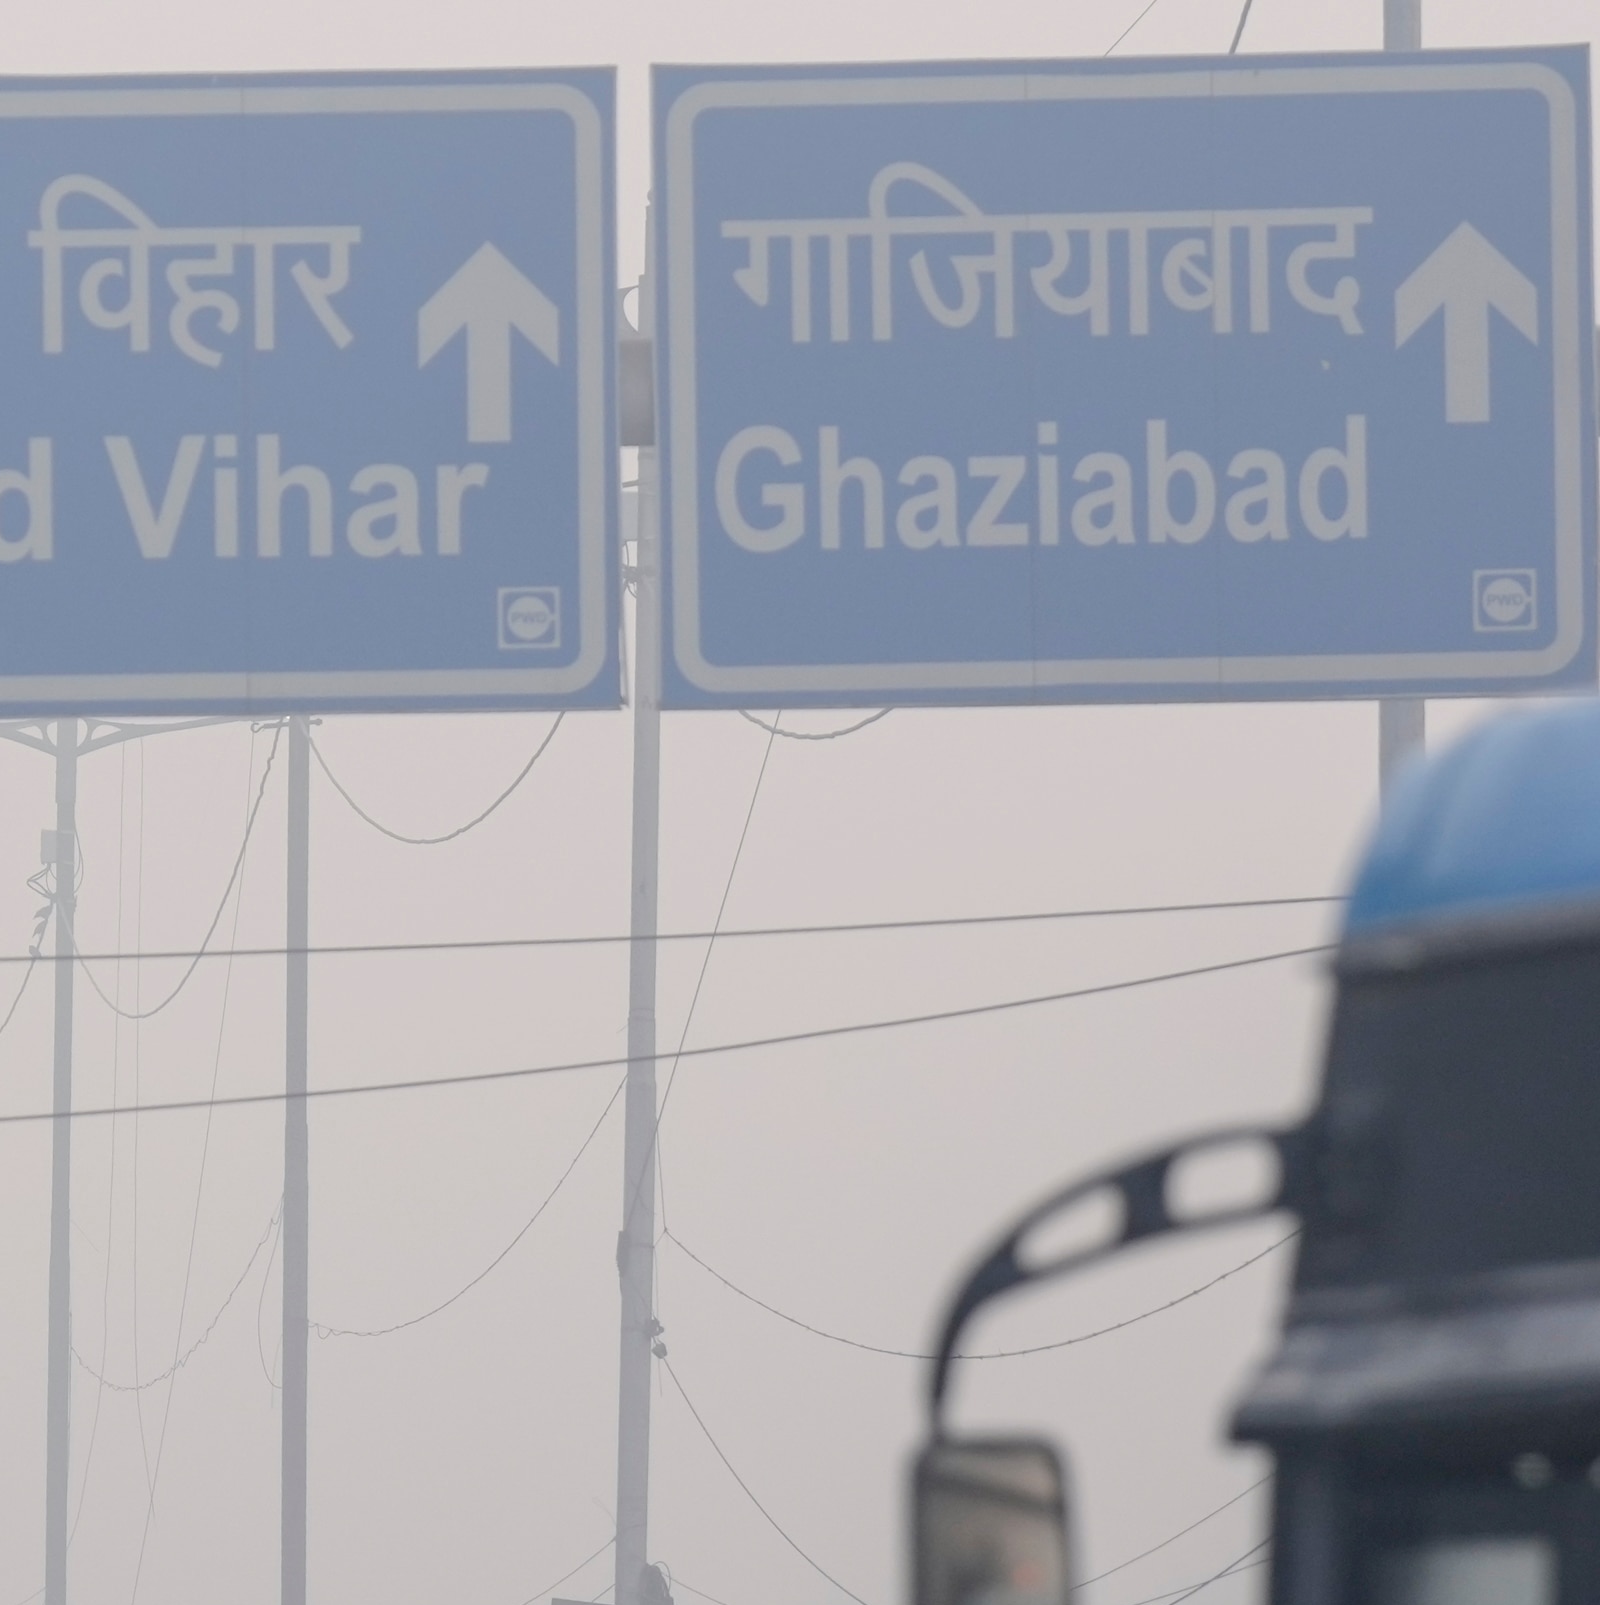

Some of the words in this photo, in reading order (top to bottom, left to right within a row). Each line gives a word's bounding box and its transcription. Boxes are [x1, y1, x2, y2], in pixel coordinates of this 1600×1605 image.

[27, 173, 362, 368] विहार
[720, 161, 1374, 343] गाजियाबाद
[103, 432, 490, 560] Vihar
[714, 414, 1369, 554] Ghaziabad
